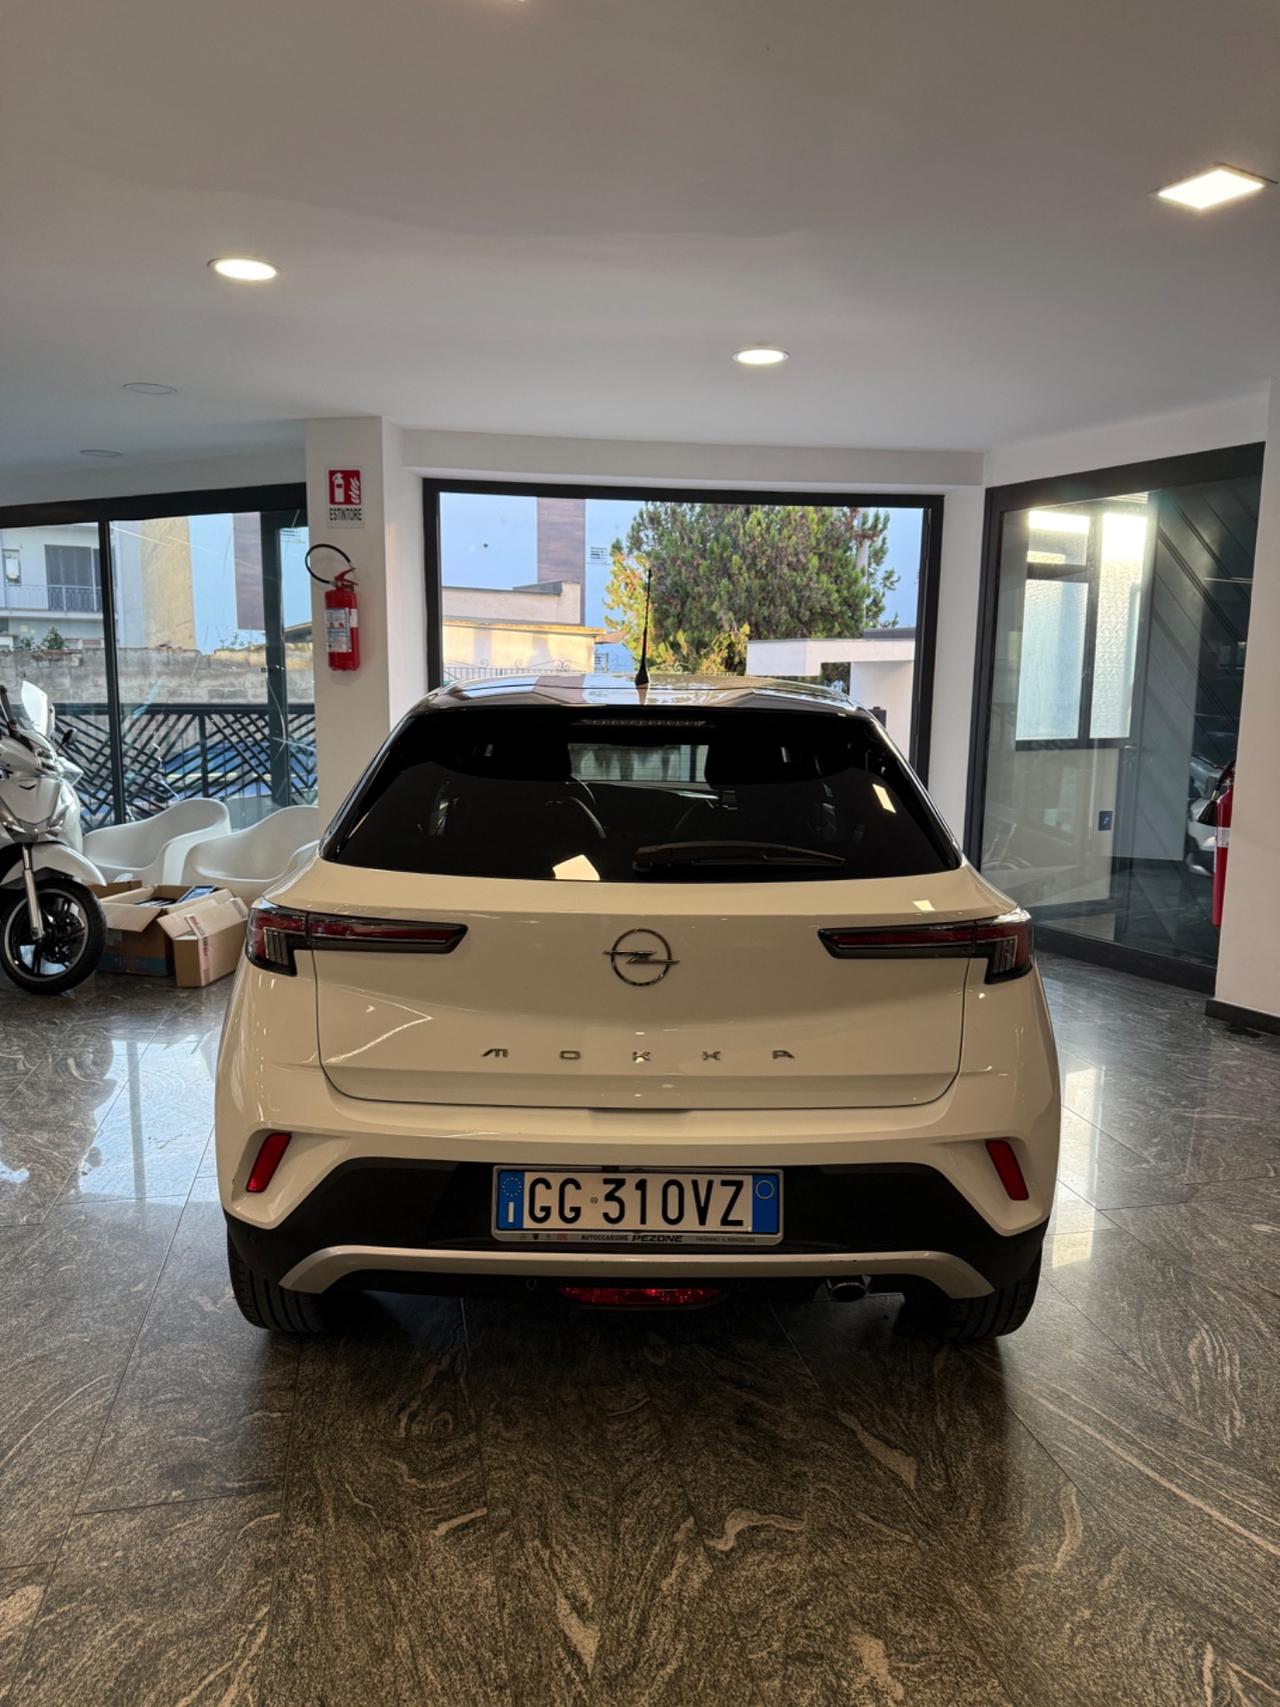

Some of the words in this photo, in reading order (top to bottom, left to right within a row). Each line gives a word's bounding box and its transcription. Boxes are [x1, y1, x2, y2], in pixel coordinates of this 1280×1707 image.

[329, 508, 362, 521] ESTINTORE
[481, 1047, 795, 1062] MOKKA
[528, 1177, 582, 1224] GG
[602, 1178, 744, 1227] 310VZ
[631, 1235, 683, 1243] PEZONE
